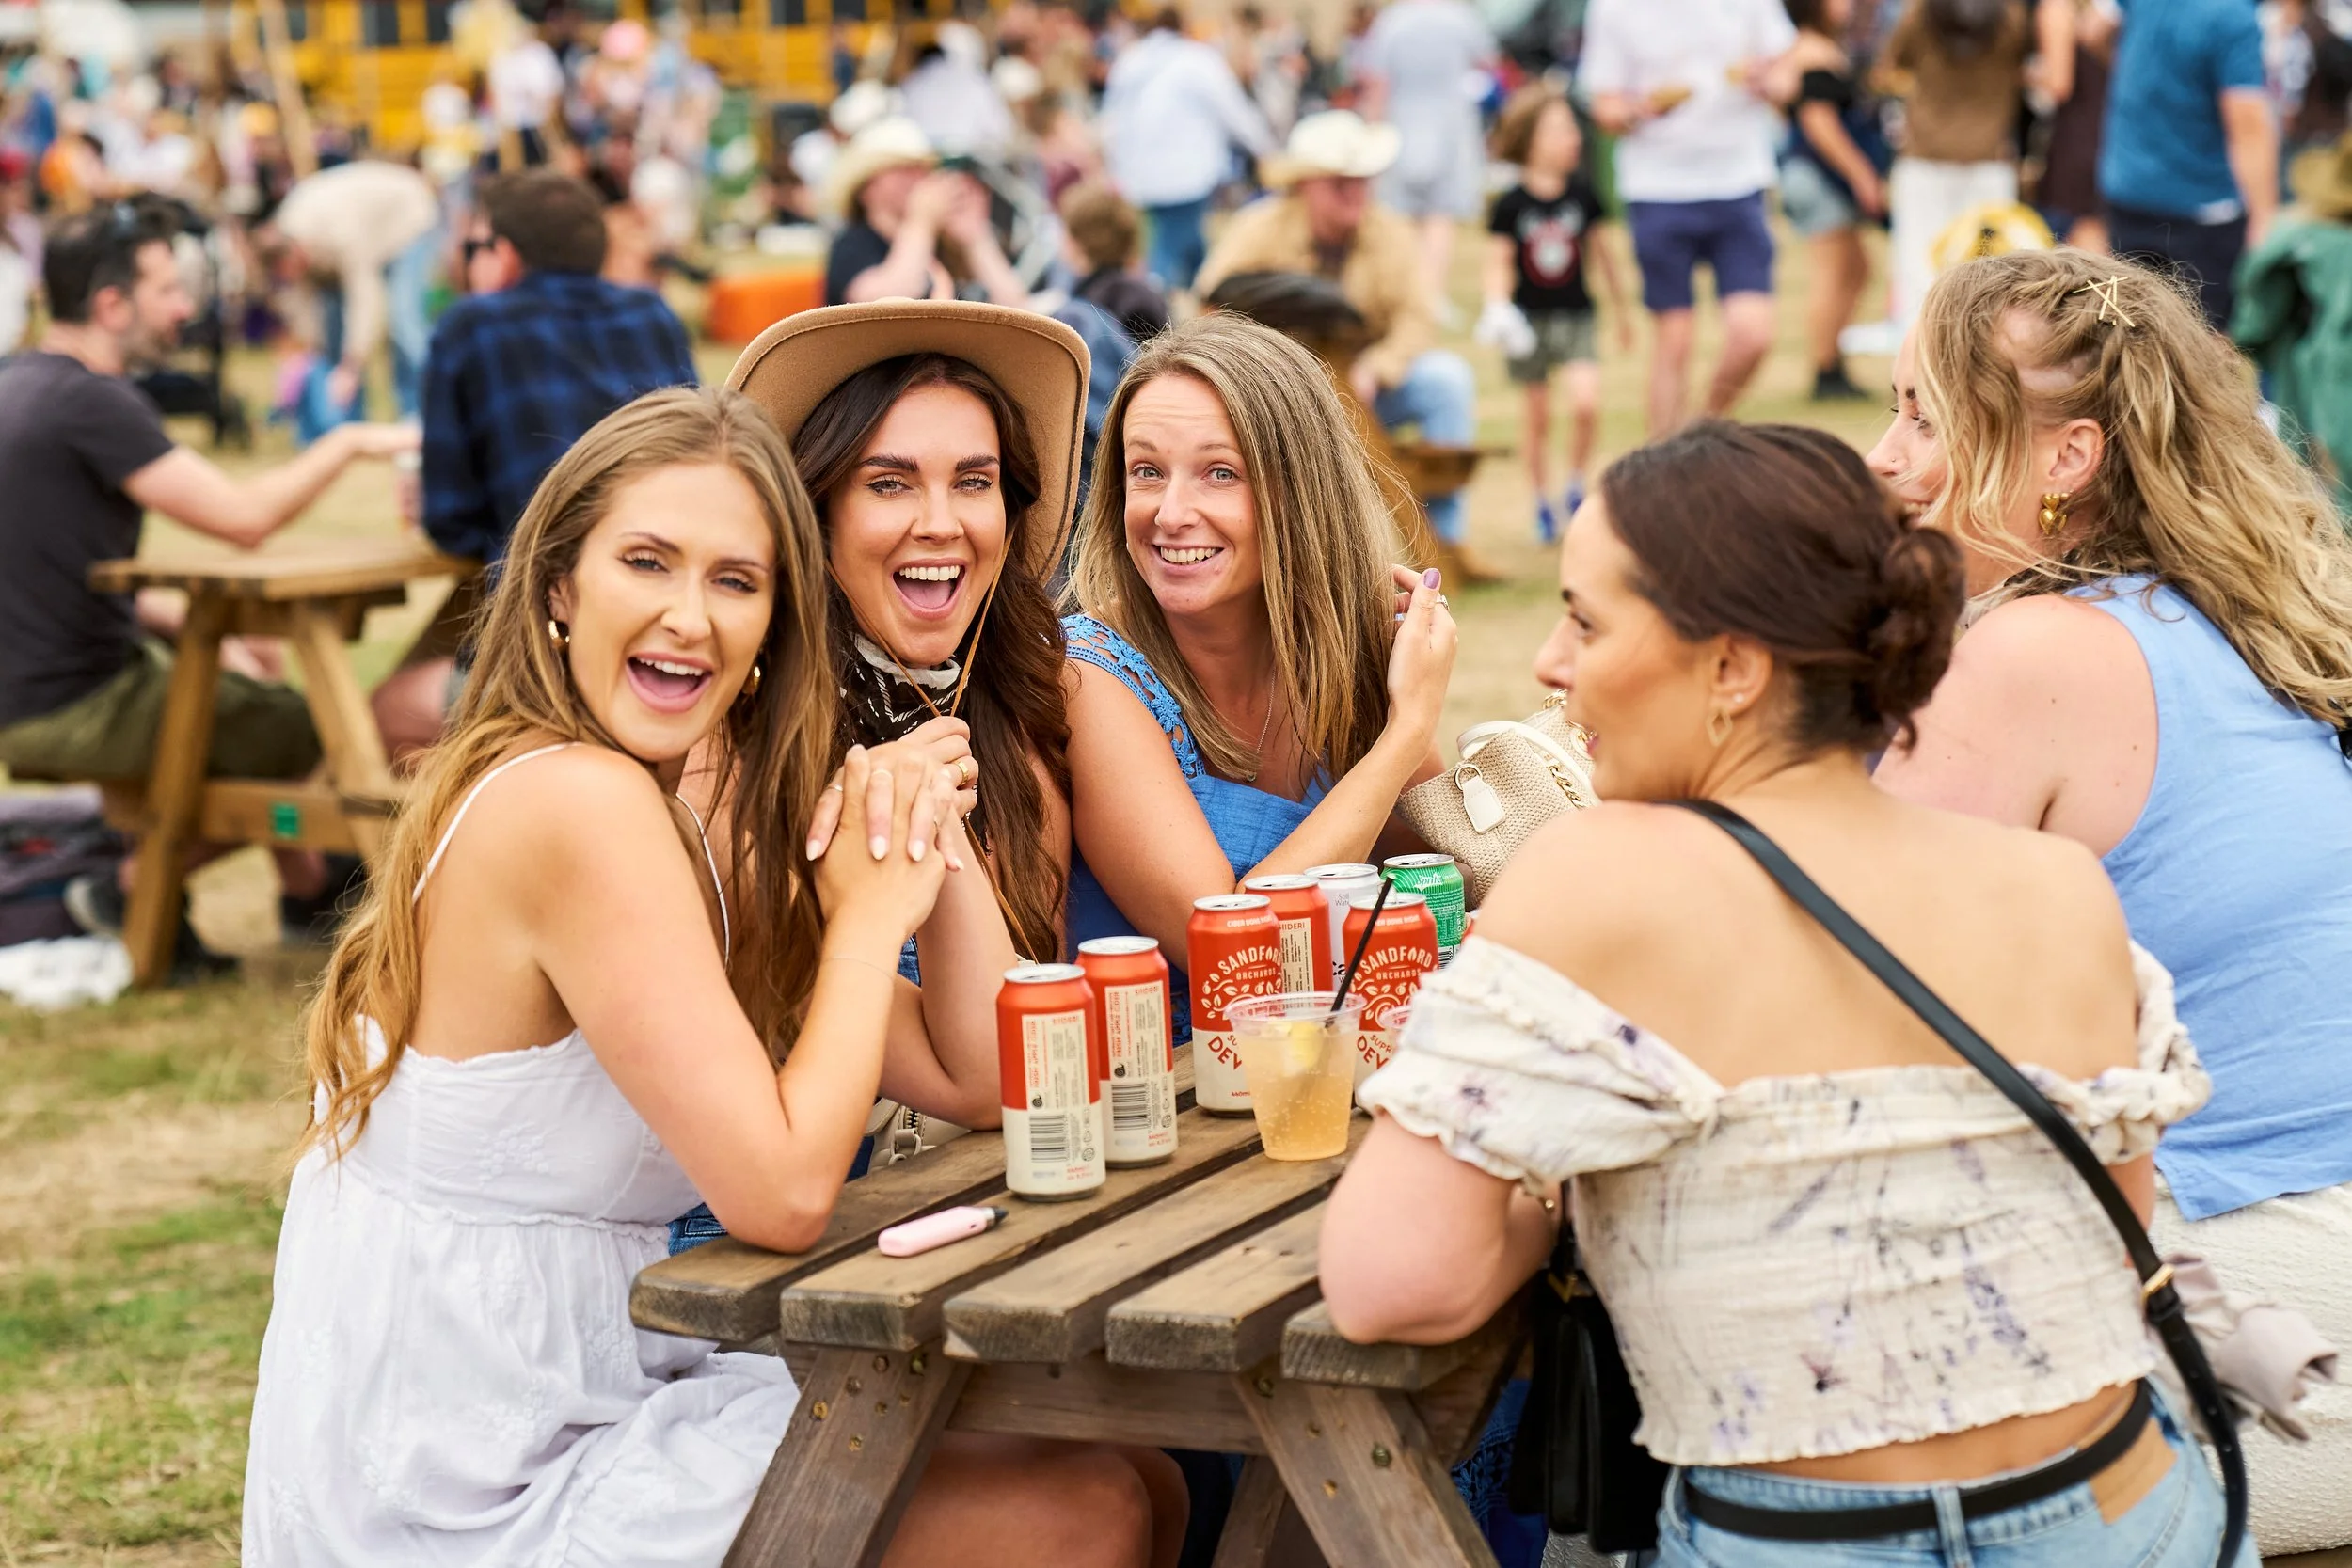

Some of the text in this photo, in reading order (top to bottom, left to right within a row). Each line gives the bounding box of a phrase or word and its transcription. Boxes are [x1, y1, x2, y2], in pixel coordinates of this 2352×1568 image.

[1418, 874, 1442, 886] Sprite
[1218, 945, 1281, 974] SANDFORD
[1359, 945, 1433, 974] SANDFORD
[1236, 968, 1276, 980] ORCHARDS
[1376, 968, 1421, 980] ORCHARDS
[1357, 1035, 1390, 1070] DEV
